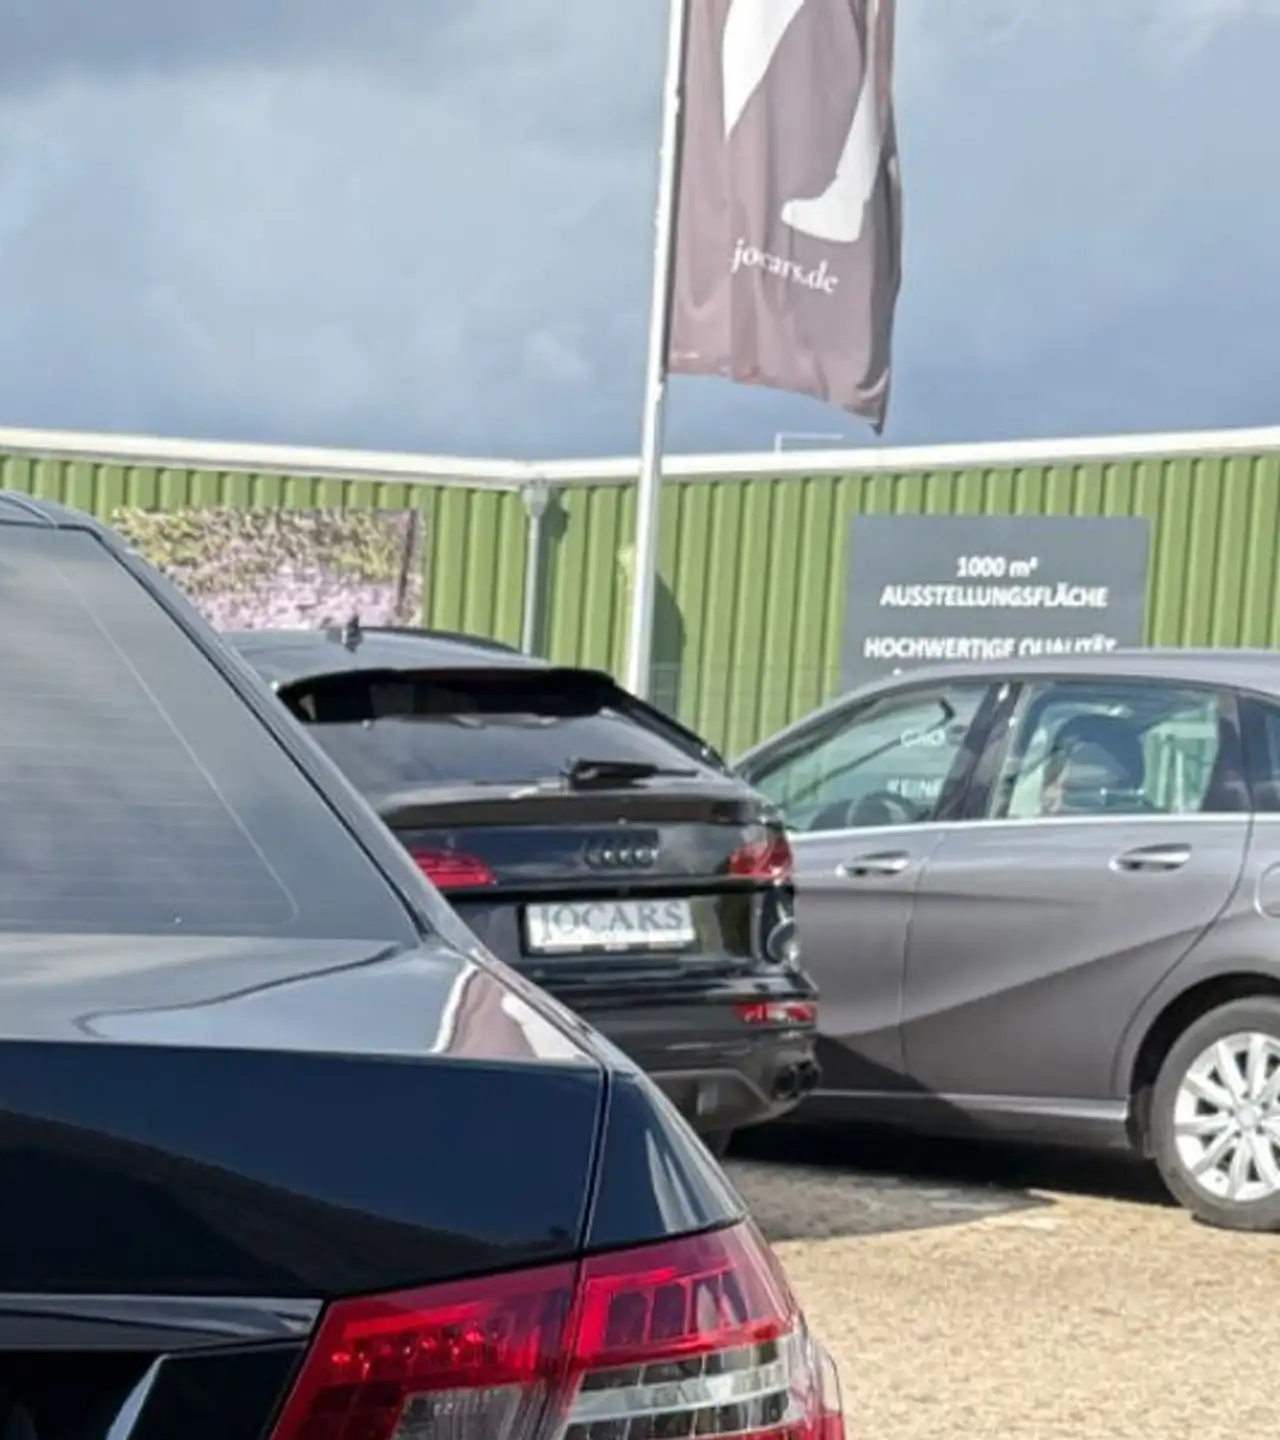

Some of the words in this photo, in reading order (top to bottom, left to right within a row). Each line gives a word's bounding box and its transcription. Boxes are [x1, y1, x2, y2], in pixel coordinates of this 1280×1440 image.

[730, 238, 838, 294] jocars.de
[956, 556, 1006, 577] 1000
[880, 582, 1109, 607] AUSSTELLUNGSFLÄCHE
[864, 636, 1016, 658] HOCHWERTIGE
[541, 900, 684, 942] JOCARS
